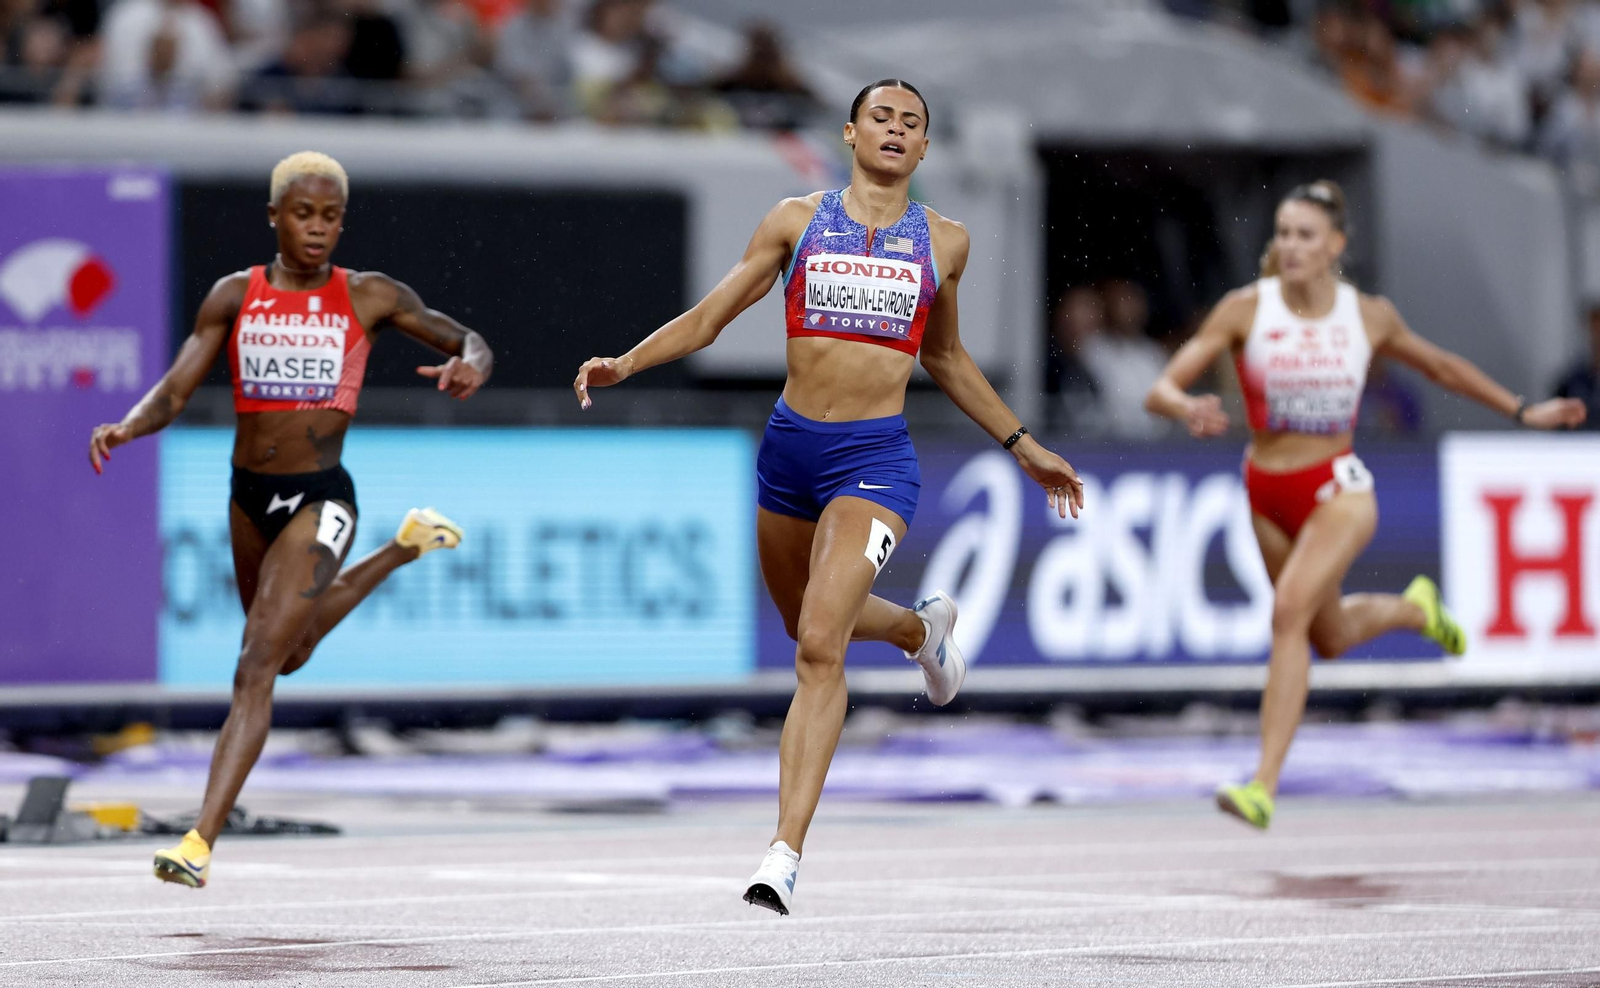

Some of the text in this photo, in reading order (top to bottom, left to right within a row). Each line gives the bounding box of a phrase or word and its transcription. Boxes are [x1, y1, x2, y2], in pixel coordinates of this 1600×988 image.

[808, 261, 917, 284] HONDA
[808, 283, 915, 317] McLAUGHLIN-LEVRONE
[241, 312, 350, 331] BAHRAIN
[241, 332, 339, 348] HONDA
[244, 356, 335, 379] NASER
[333, 514, 346, 541] 7
[877, 533, 892, 567] 5
